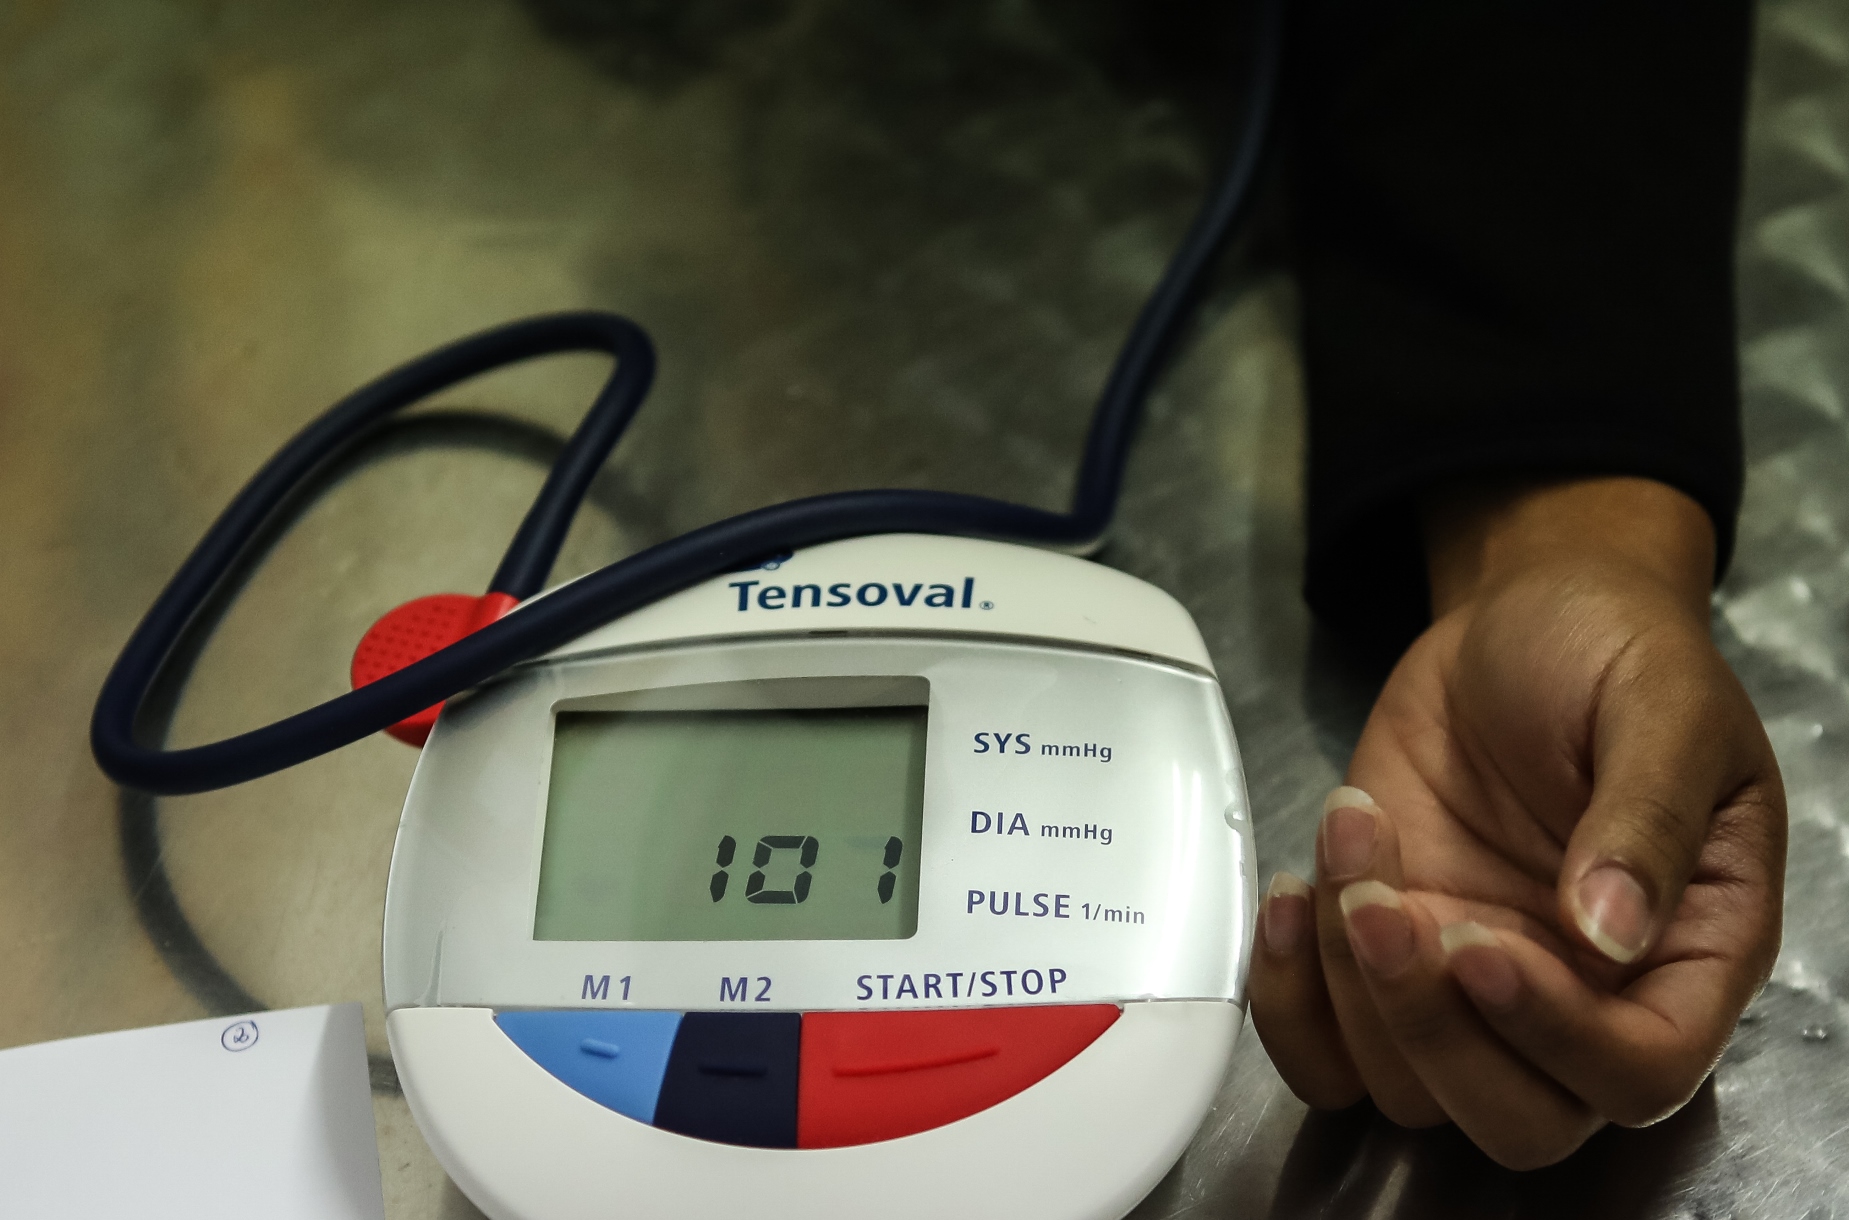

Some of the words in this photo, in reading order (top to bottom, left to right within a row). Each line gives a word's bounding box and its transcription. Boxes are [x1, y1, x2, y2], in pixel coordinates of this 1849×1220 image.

[973, 732, 1031, 754] SYS
[1041, 743, 1112, 763] mmHg
[970, 811, 1030, 836] DIA
[1041, 823, 1113, 846] mmHg
[967, 890, 1070, 919] PULSE
[1081, 902, 1145, 924] 1/min
[857, 968, 1068, 1000] START/STOP
